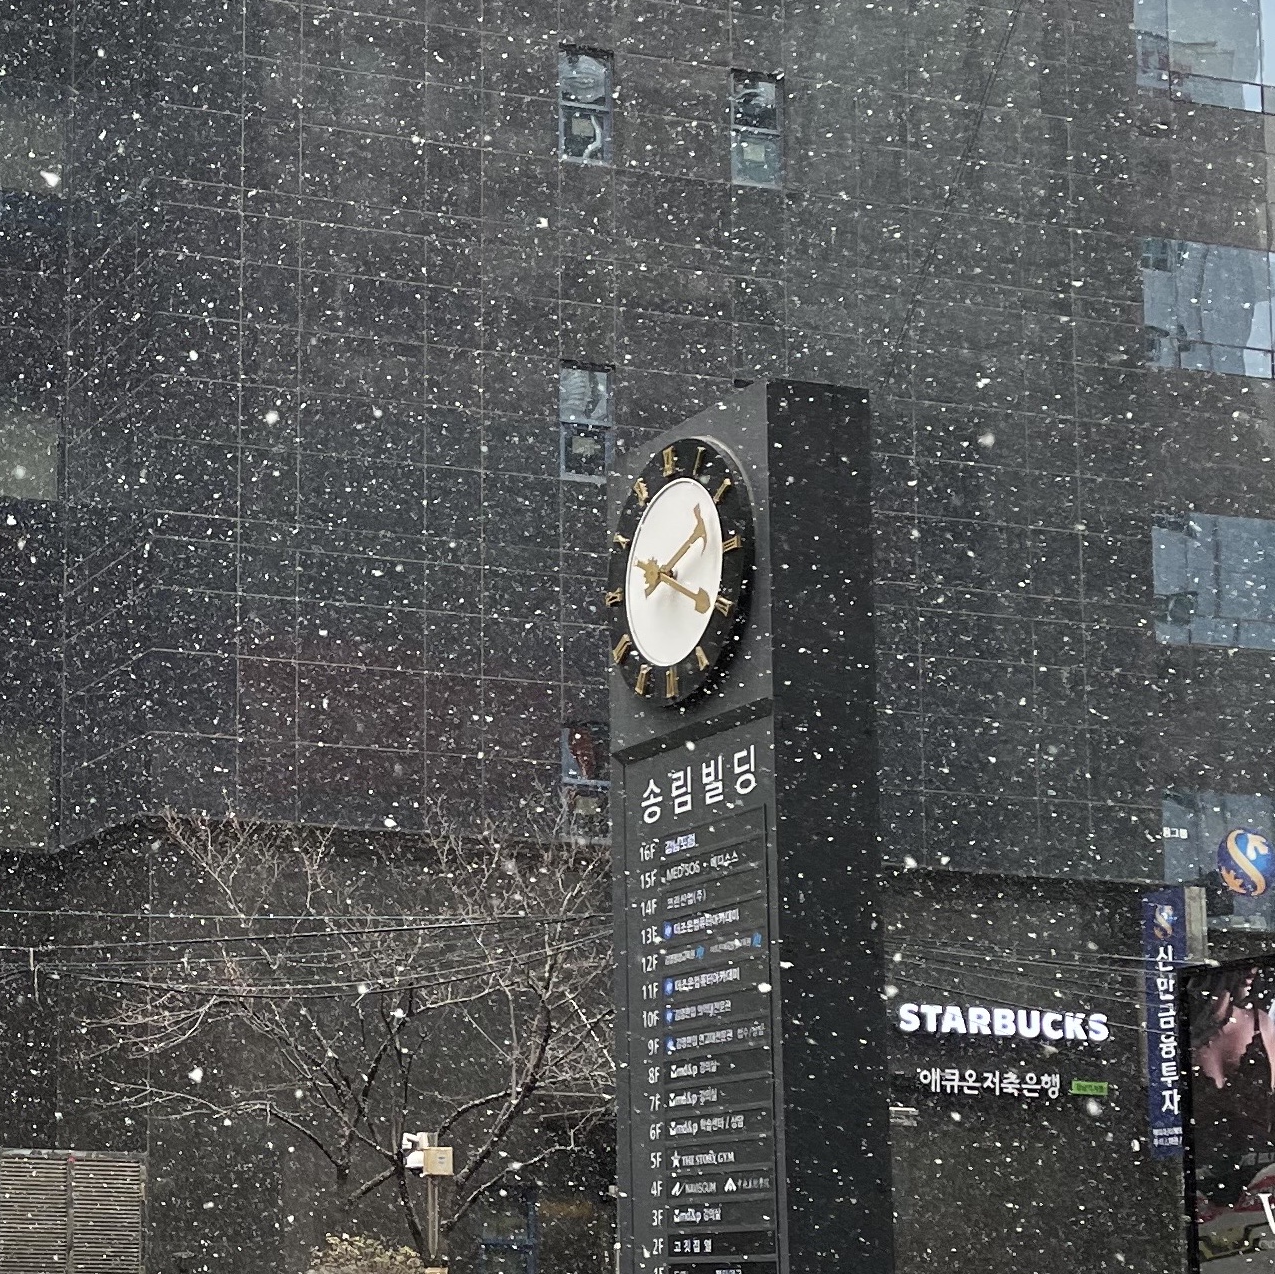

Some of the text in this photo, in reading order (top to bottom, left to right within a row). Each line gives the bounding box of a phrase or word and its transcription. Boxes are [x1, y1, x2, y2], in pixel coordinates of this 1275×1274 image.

[641, 744, 757, 824] 송림빌딩
[639, 843, 656, 862] 16F
[640, 869, 657, 889] 15F
[640, 899, 657, 917] 14F
[641, 925, 658, 944] 13F
[641, 954, 658, 973] 12F
[642, 982, 658, 1000] 11F
[643, 1010, 659, 1028] 10F
[899, 1003, 1110, 1041] STARBUCKS
[648, 1038, 660, 1055] 9F
[648, 1067, 660, 1083] 8F
[918, 1069, 1060, 1099] 애큐온저축은행
[649, 1094, 660, 1111] 7F
[650, 1123, 661, 1140] 6F
[650, 1152, 662, 1168] 5F
[650, 1180, 663, 1196] 4F
[652, 1209, 663, 1226] 3F
[652, 1238, 664, 1254] 2F
